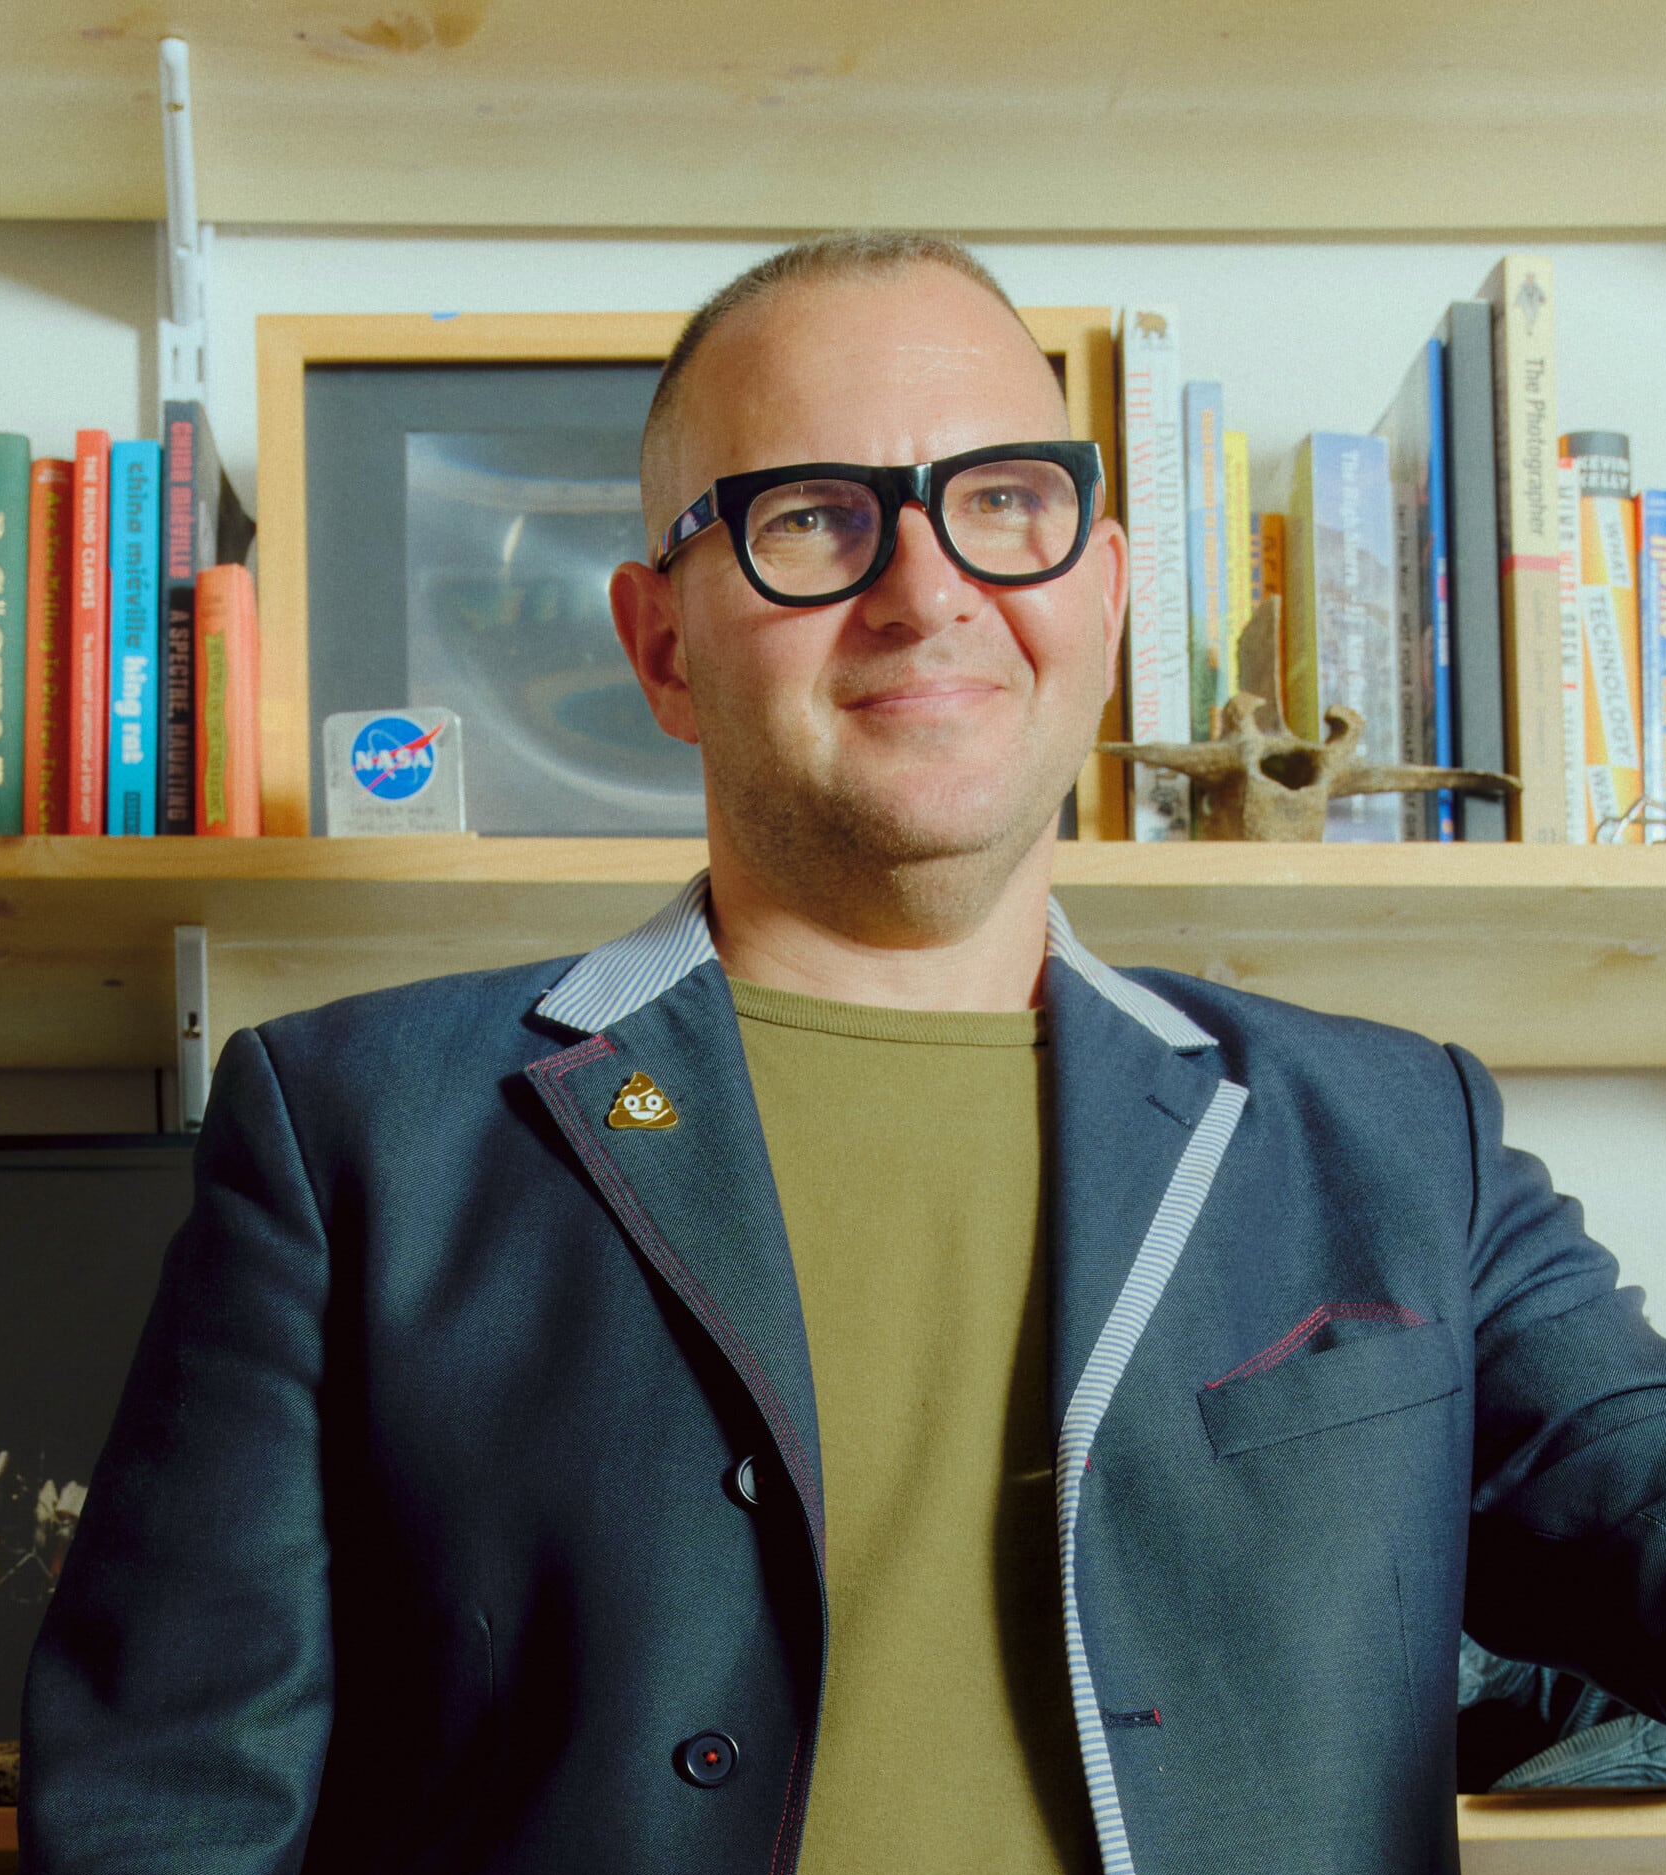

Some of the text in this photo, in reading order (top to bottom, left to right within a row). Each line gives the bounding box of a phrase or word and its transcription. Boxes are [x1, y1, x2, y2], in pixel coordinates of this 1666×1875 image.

[1522, 356, 1549, 537] The Photographer
[125, 462, 151, 648] china miéville
[1127, 368, 1161, 744] THE WAY THINGS WORK
[1154, 420, 1185, 683] DAVID MACAULAY
[1589, 521, 1633, 760] WHAT TECHNOLOGY
[113, 655, 149, 765] king rat
[353, 748, 434, 772] NASA
